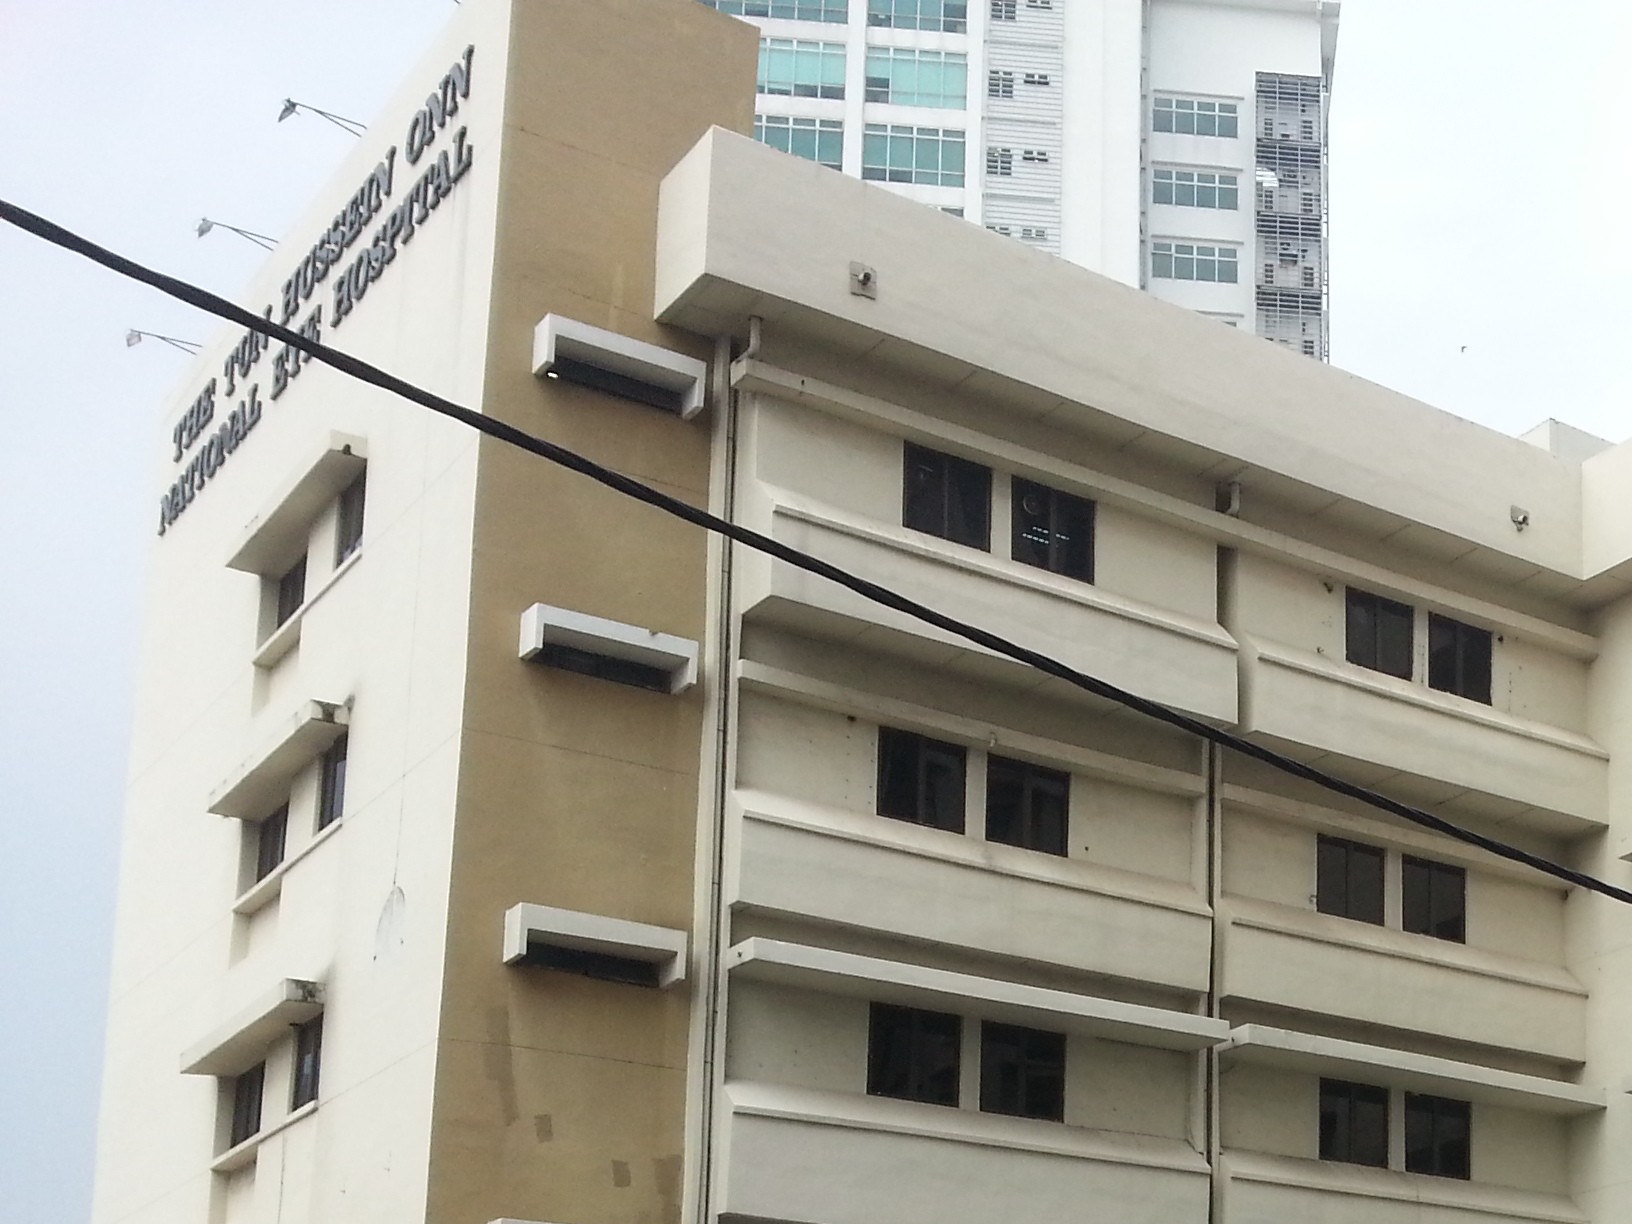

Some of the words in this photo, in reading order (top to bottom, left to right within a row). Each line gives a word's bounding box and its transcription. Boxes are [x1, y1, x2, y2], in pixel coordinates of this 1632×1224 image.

[158, 383, 262, 536] NATIONAL
[270, 304, 322, 401] EYE
[330, 125, 473, 328] HOSPITAL
[173, 378, 216, 463] THE
[224, 304, 273, 397] TUN
[280, 145, 397, 325] HUSSEIN
[405, 44, 475, 166] ONN
